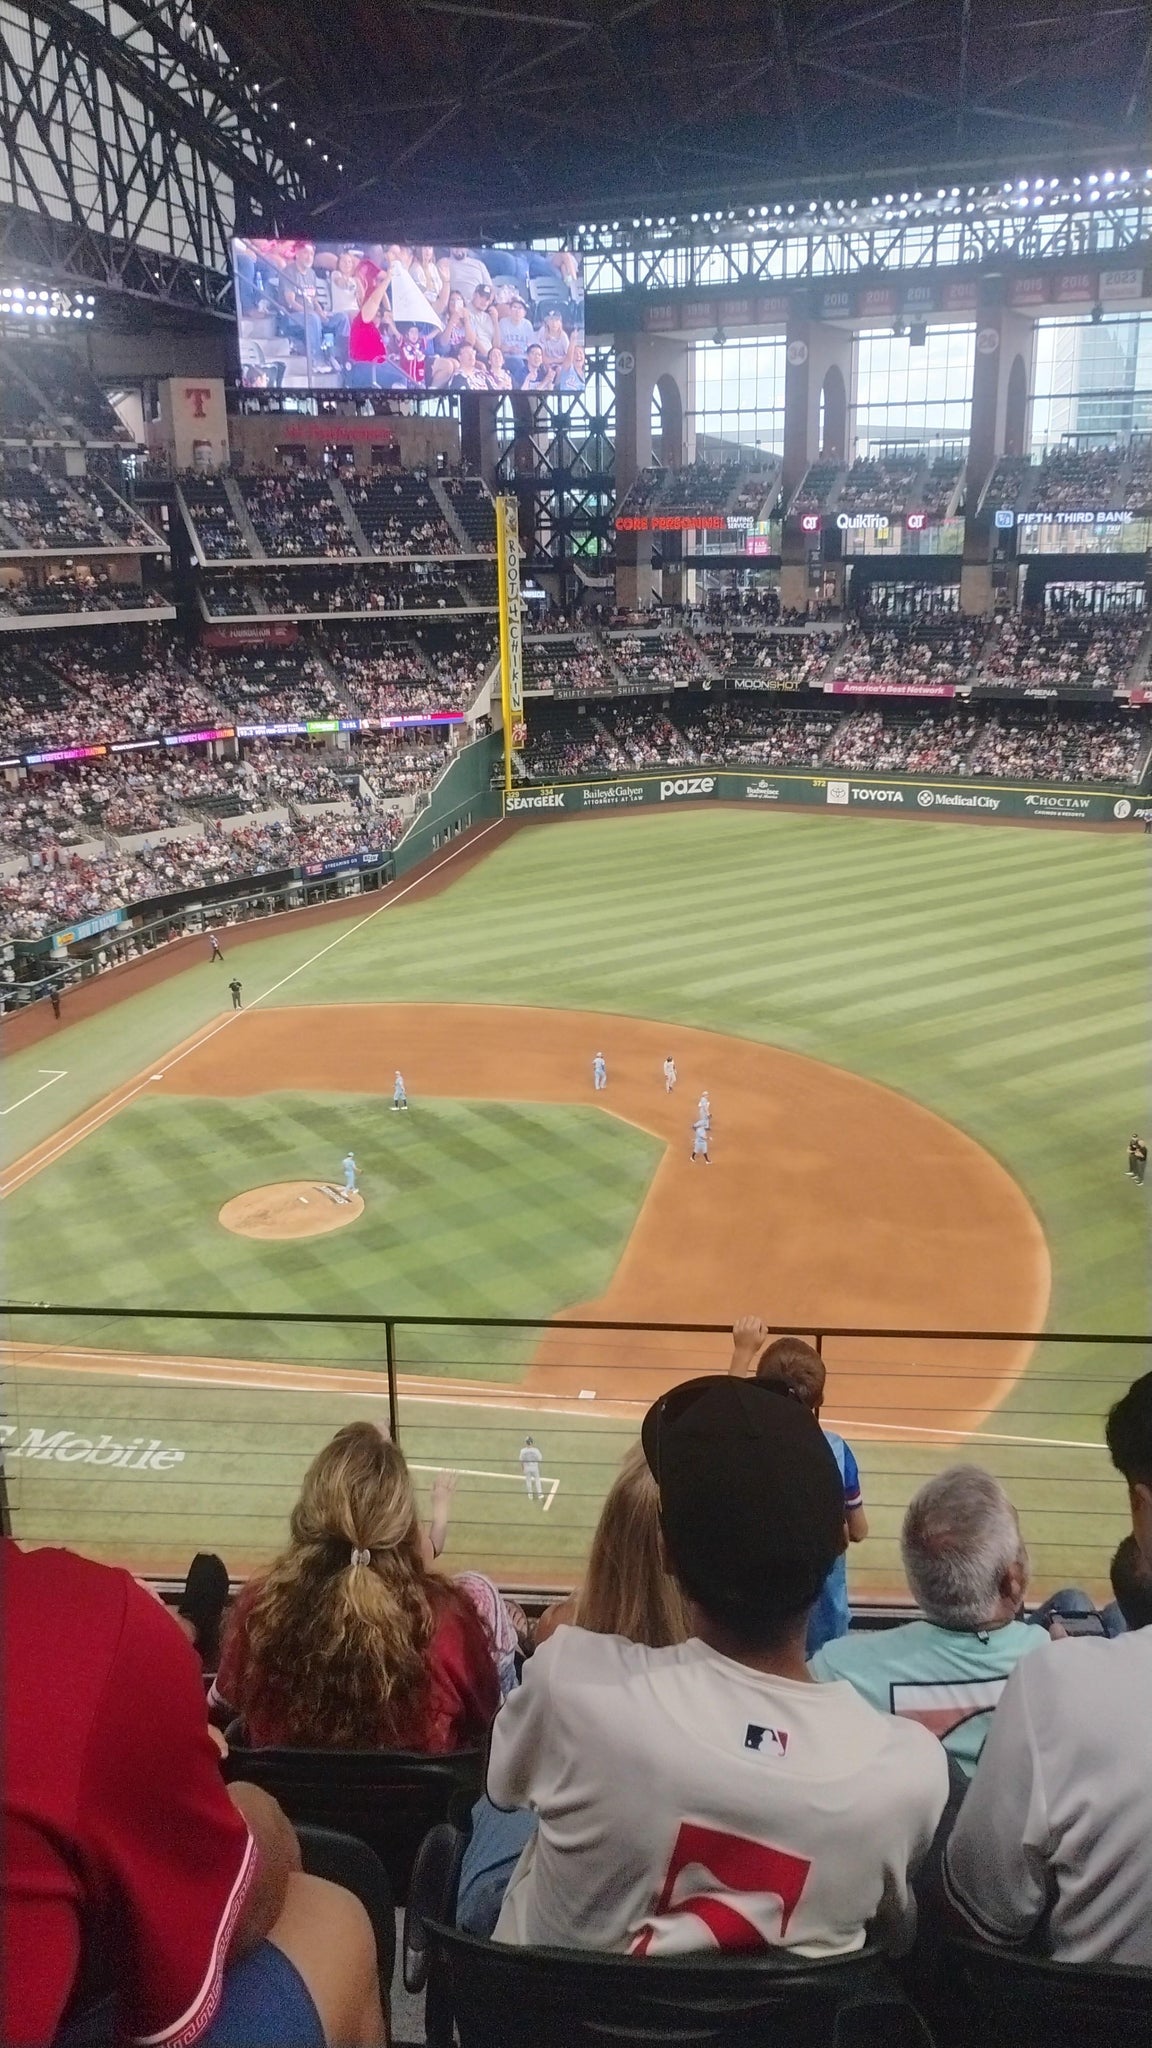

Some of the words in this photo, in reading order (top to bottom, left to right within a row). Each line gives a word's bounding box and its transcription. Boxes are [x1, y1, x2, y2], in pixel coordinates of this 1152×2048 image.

[1106, 271, 1136, 285] 2023
[790, 346, 806, 361] 34
[618, 356, 632, 370] 42
[185, 388, 211, 418] T
[803, 516, 818, 530] QT
[837, 513, 889, 529] QuikTrip
[908, 514, 925, 529] QT
[1017, 513, 1053, 524] FIFTH
[1056, 511, 1095, 523] THIRD
[1096, 511, 1133, 523] BANK
[508, 540, 518, 595] ROOT
[734, 679, 800, 690] MOONSHOT
[842, 684, 886, 693] America's
[886, 685, 906, 693] Best
[906, 686, 944, 695] Network
[1023, 688, 1058, 696] ARENA
[583, 785, 643, 799] Bailey&Galyen
[660, 776, 714, 800] paze
[851, 788, 904, 802] TOYOTA
[506, 793, 565, 811] SEATGEEK
[583, 798, 618, 806] ATTORNEYS
[935, 794, 977, 807] Medical
[977, 796, 1000, 810] City
[1029, 795, 1090, 808] CHOCTAW
[324, 859, 350, 869] STREAMING
